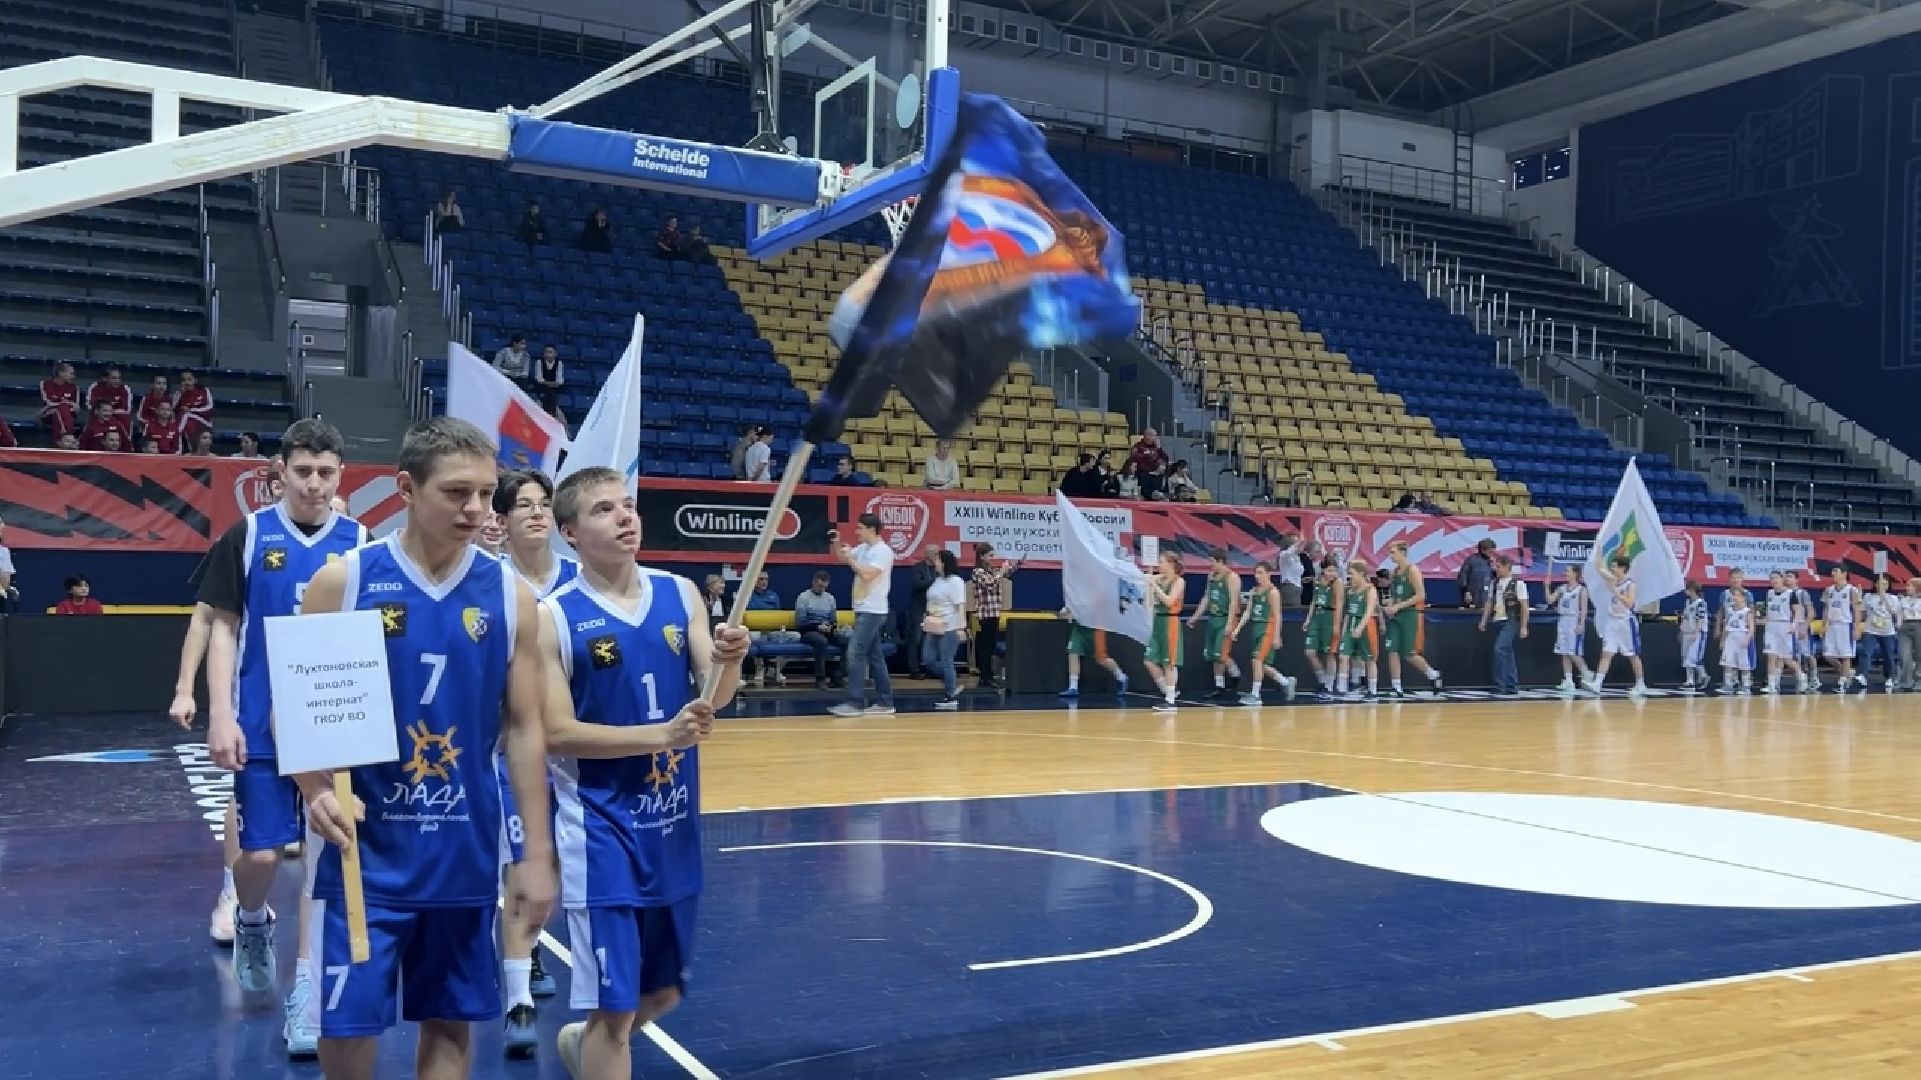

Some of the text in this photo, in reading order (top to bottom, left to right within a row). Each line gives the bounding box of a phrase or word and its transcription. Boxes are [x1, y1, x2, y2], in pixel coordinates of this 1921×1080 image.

[635, 139, 710, 167] Schelde
[633, 156, 708, 179] International
[687, 512, 766, 532] Winline
[954, 506, 985, 518] XXIII
[987, 507, 1035, 521] Winline
[1038, 509, 1060, 525] Куб
[967, 525, 1060, 539] среди мужски
[996, 540, 1063, 553] по баскет
[313, 679, 358, 690] школа-
[419, 652, 448, 705] 7
[305, 691, 369, 709] интернат"
[640, 672, 664, 720] 1
[313, 711, 366, 725] ГКОУ ВО
[507, 814, 524, 844] 8
[595, 947, 612, 988] 1
[324, 964, 350, 1012] 7
